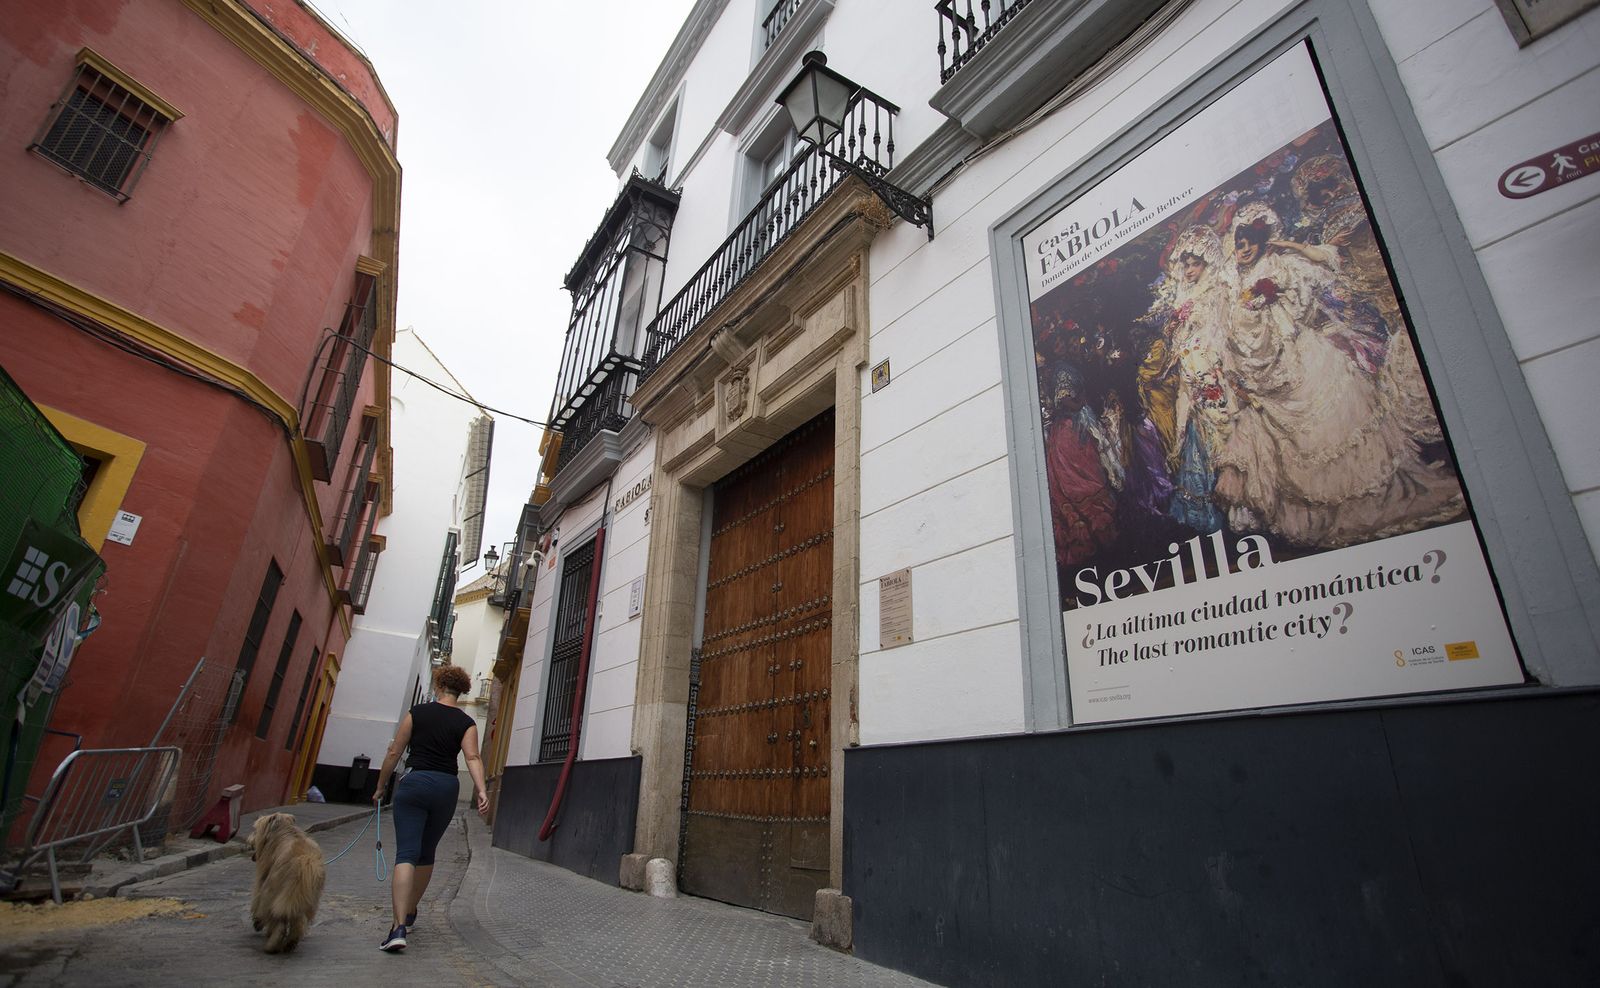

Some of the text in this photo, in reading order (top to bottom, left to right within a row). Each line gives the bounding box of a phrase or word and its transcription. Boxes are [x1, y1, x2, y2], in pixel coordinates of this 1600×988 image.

[1578, 141, 1600, 154] Ca
[1037, 221, 1080, 255] Casa
[1040, 197, 1146, 276] FABIOLA
[1041, 186, 1194, 288] Donación de Arte Mariano Bellver
[614, 473, 652, 512] FABIOLA
[1074, 528, 1281, 609] Sevilla
[1082, 549, 1447, 649] ¿La última ciudad romántica?
[1098, 602, 1353, 667] The last romantic city?
[1412, 645, 1436, 655] ICAS
